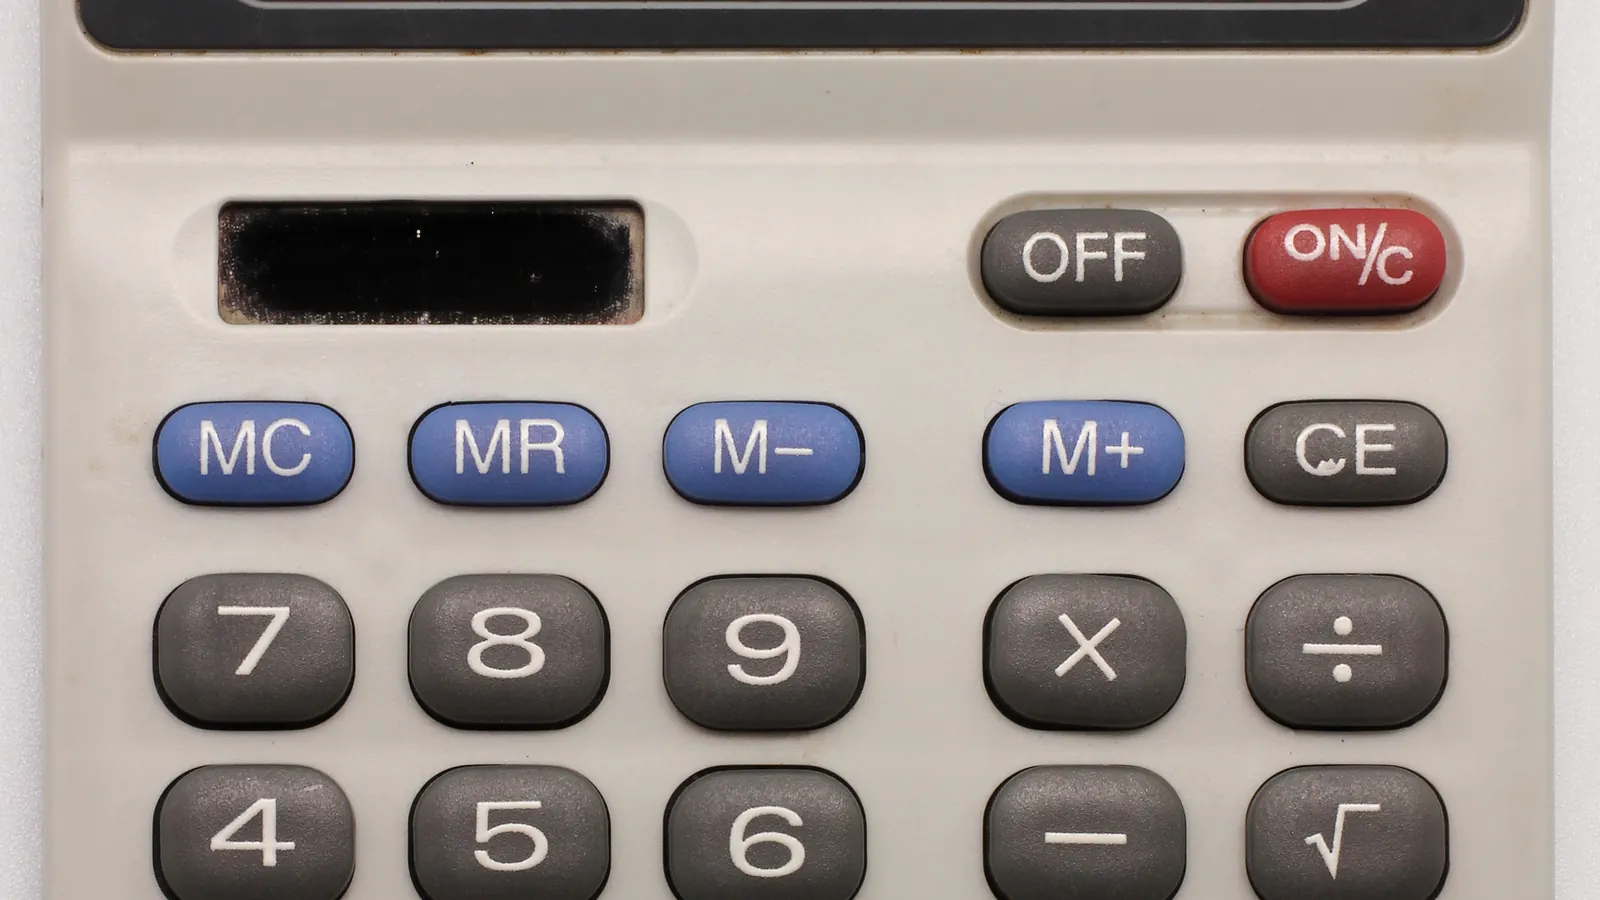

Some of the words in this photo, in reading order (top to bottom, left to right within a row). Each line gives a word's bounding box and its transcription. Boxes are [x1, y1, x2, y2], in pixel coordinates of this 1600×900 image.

[1023, 232, 1147, 282] OFF
[1284, 223, 1414, 285] ON/C
[200, 418, 312, 476] MC
[456, 419, 566, 474] MR
[1043, 419, 1145, 476] M+
[1296, 423, 1397, 476] CE
[218, 606, 291, 676] 7
[467, 607, 546, 679] 8
[726, 613, 801, 686] 9
[210, 798, 296, 867] 4
[475, 801, 549, 871] 5
[730, 806, 806, 878] 6
